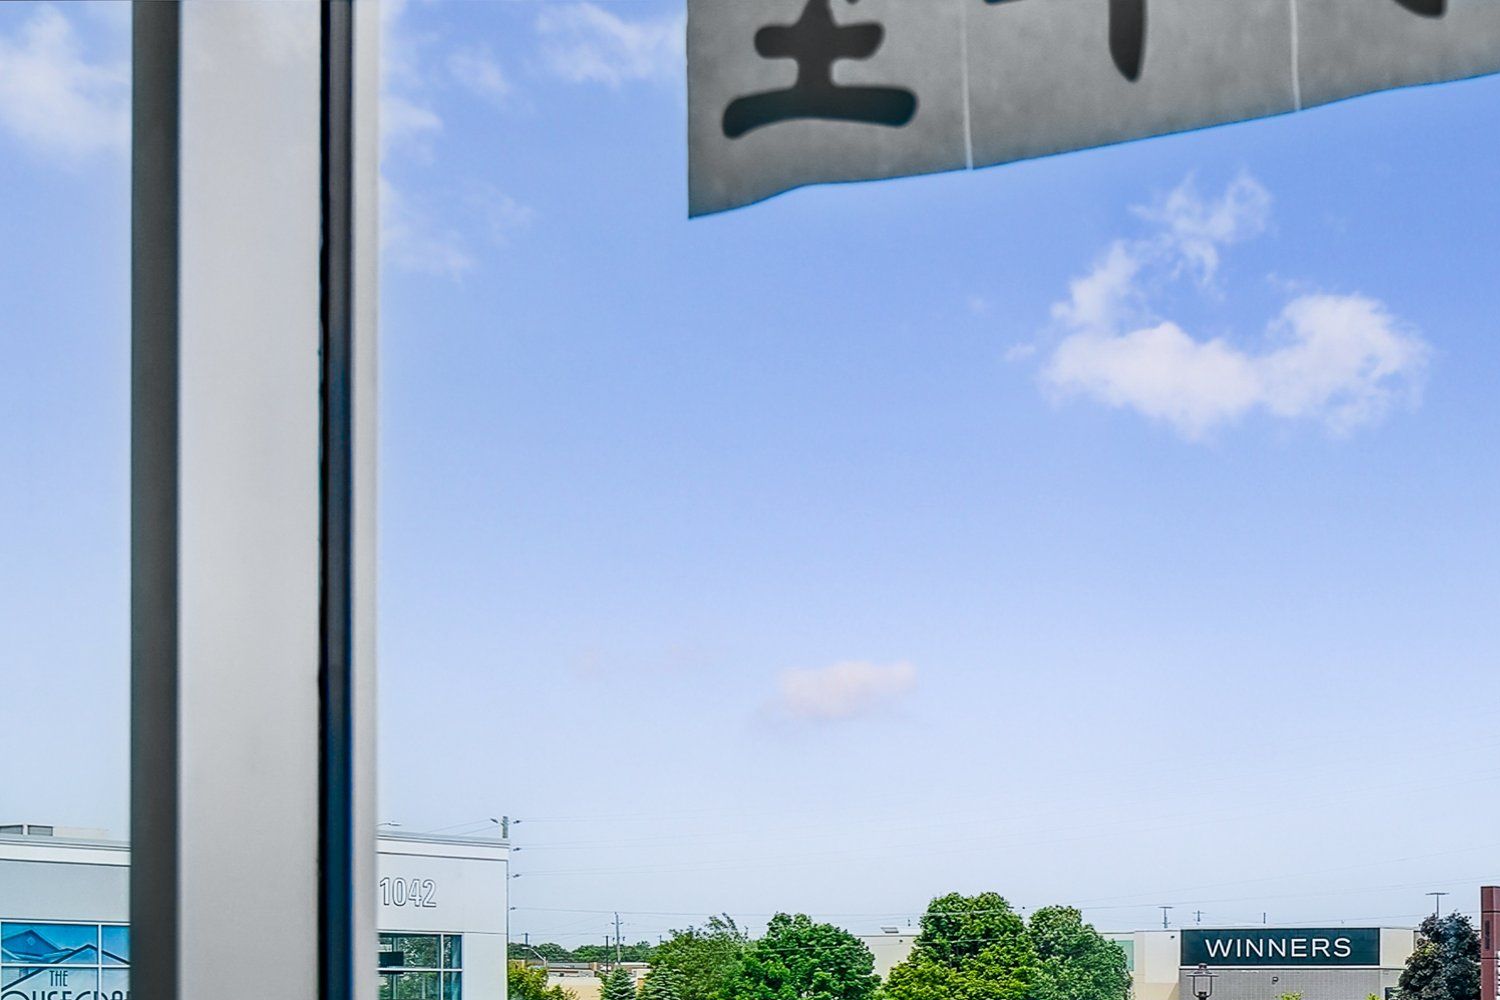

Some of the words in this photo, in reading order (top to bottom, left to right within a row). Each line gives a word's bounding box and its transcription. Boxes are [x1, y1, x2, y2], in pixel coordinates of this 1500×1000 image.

[379, 877, 437, 908] 1042
[1205, 937, 1352, 959] WINNERS
[50, 970, 68, 987] THE
